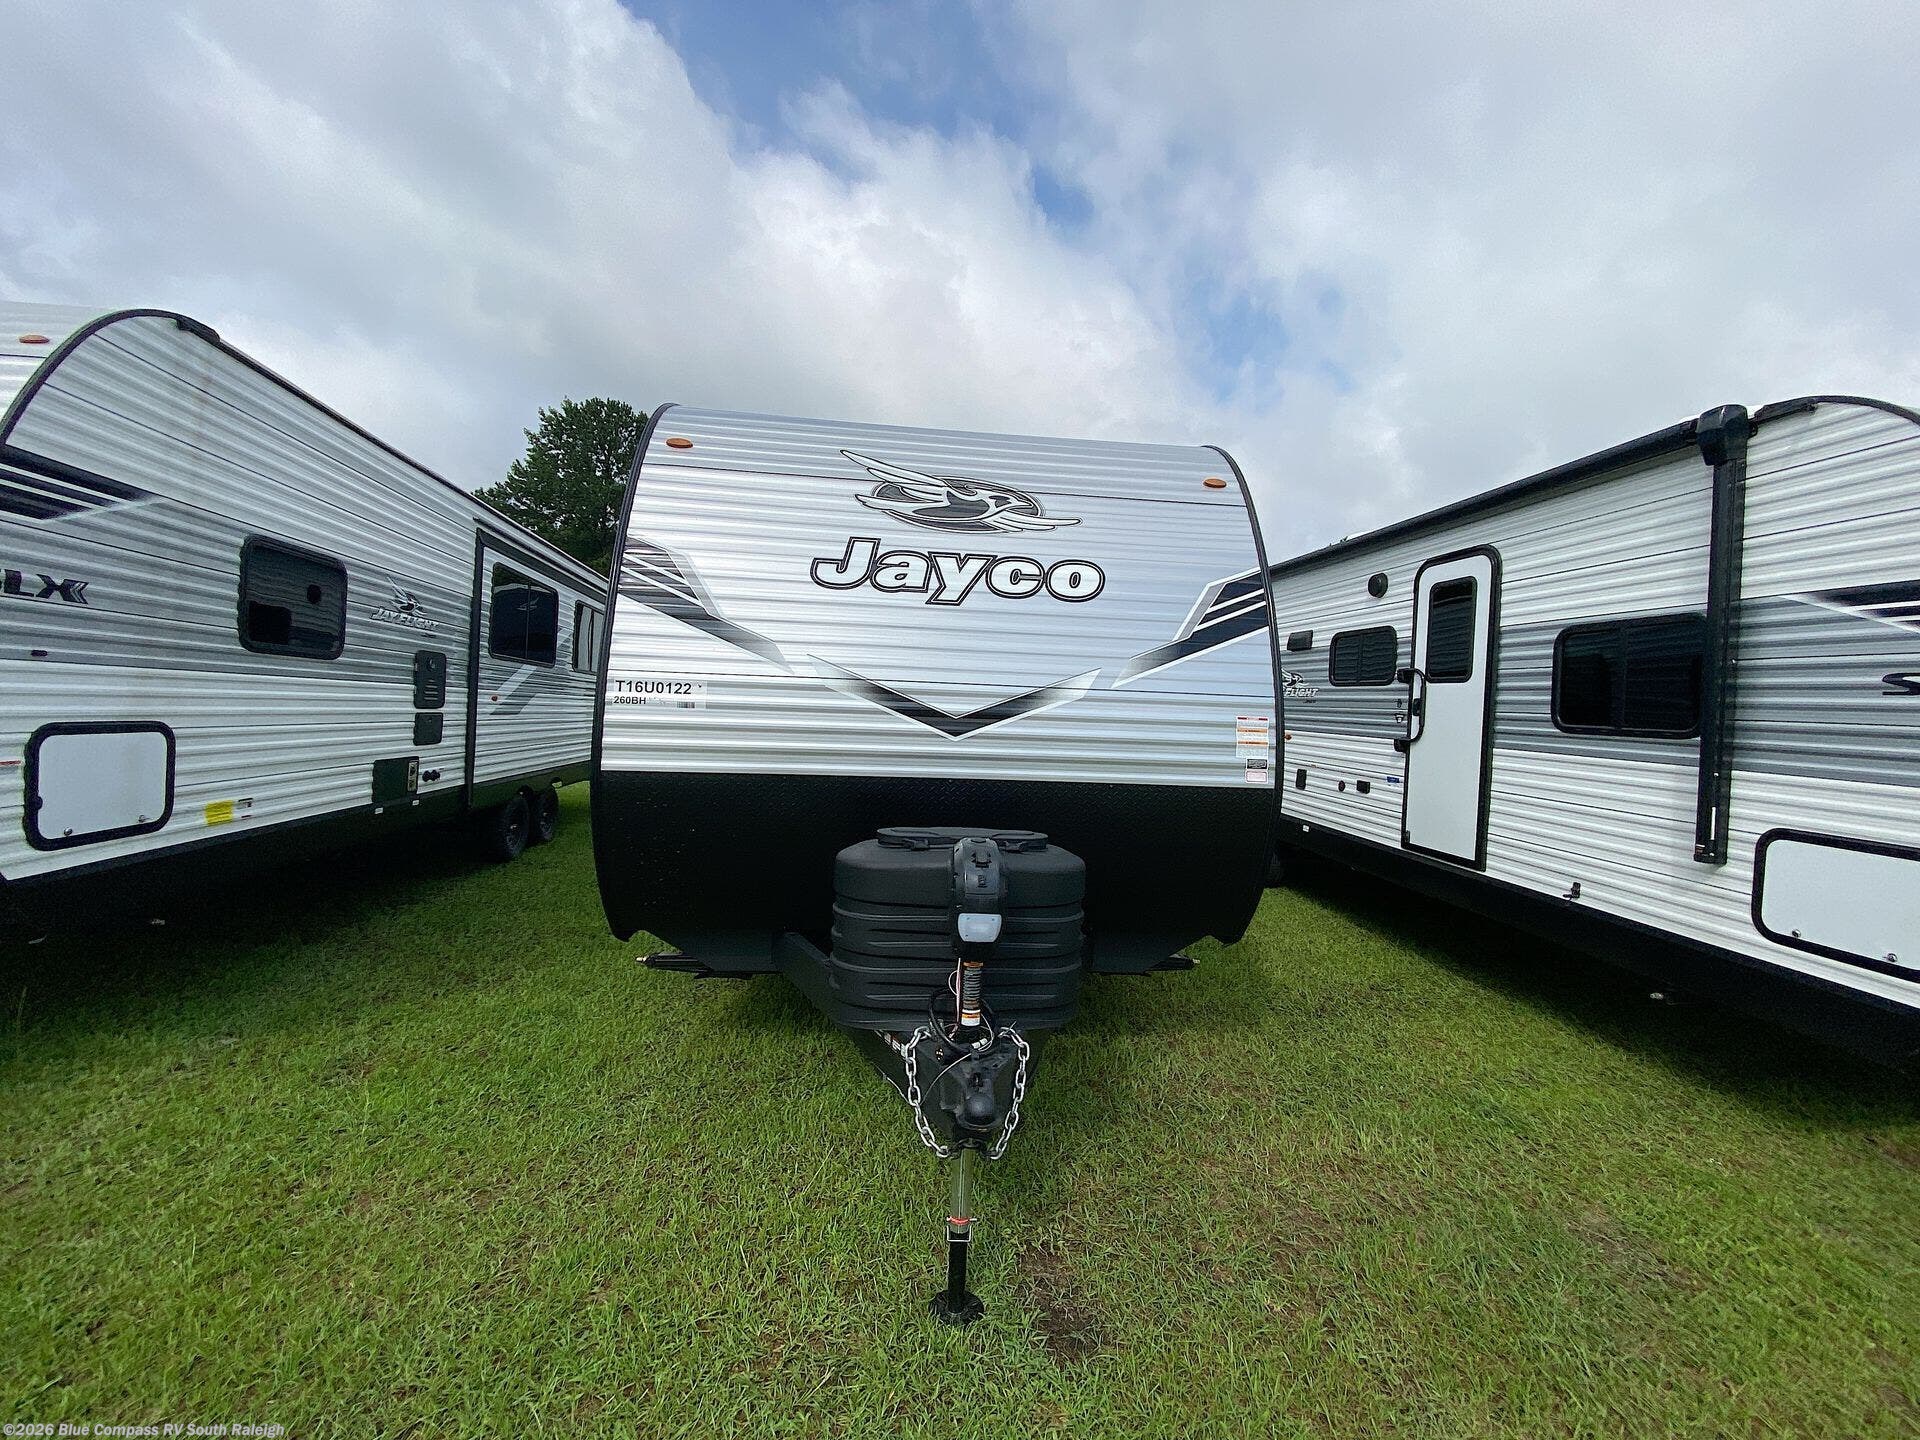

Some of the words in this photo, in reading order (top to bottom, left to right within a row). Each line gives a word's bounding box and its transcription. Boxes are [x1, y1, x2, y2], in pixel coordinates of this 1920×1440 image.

[810, 536, 1106, 606] Jayco
[0, 568, 89, 605] LX
[615, 680, 692, 694] T16U0122
[1284, 687, 1319, 698] FLIGHT
[613, 696, 646, 704] 260BH
